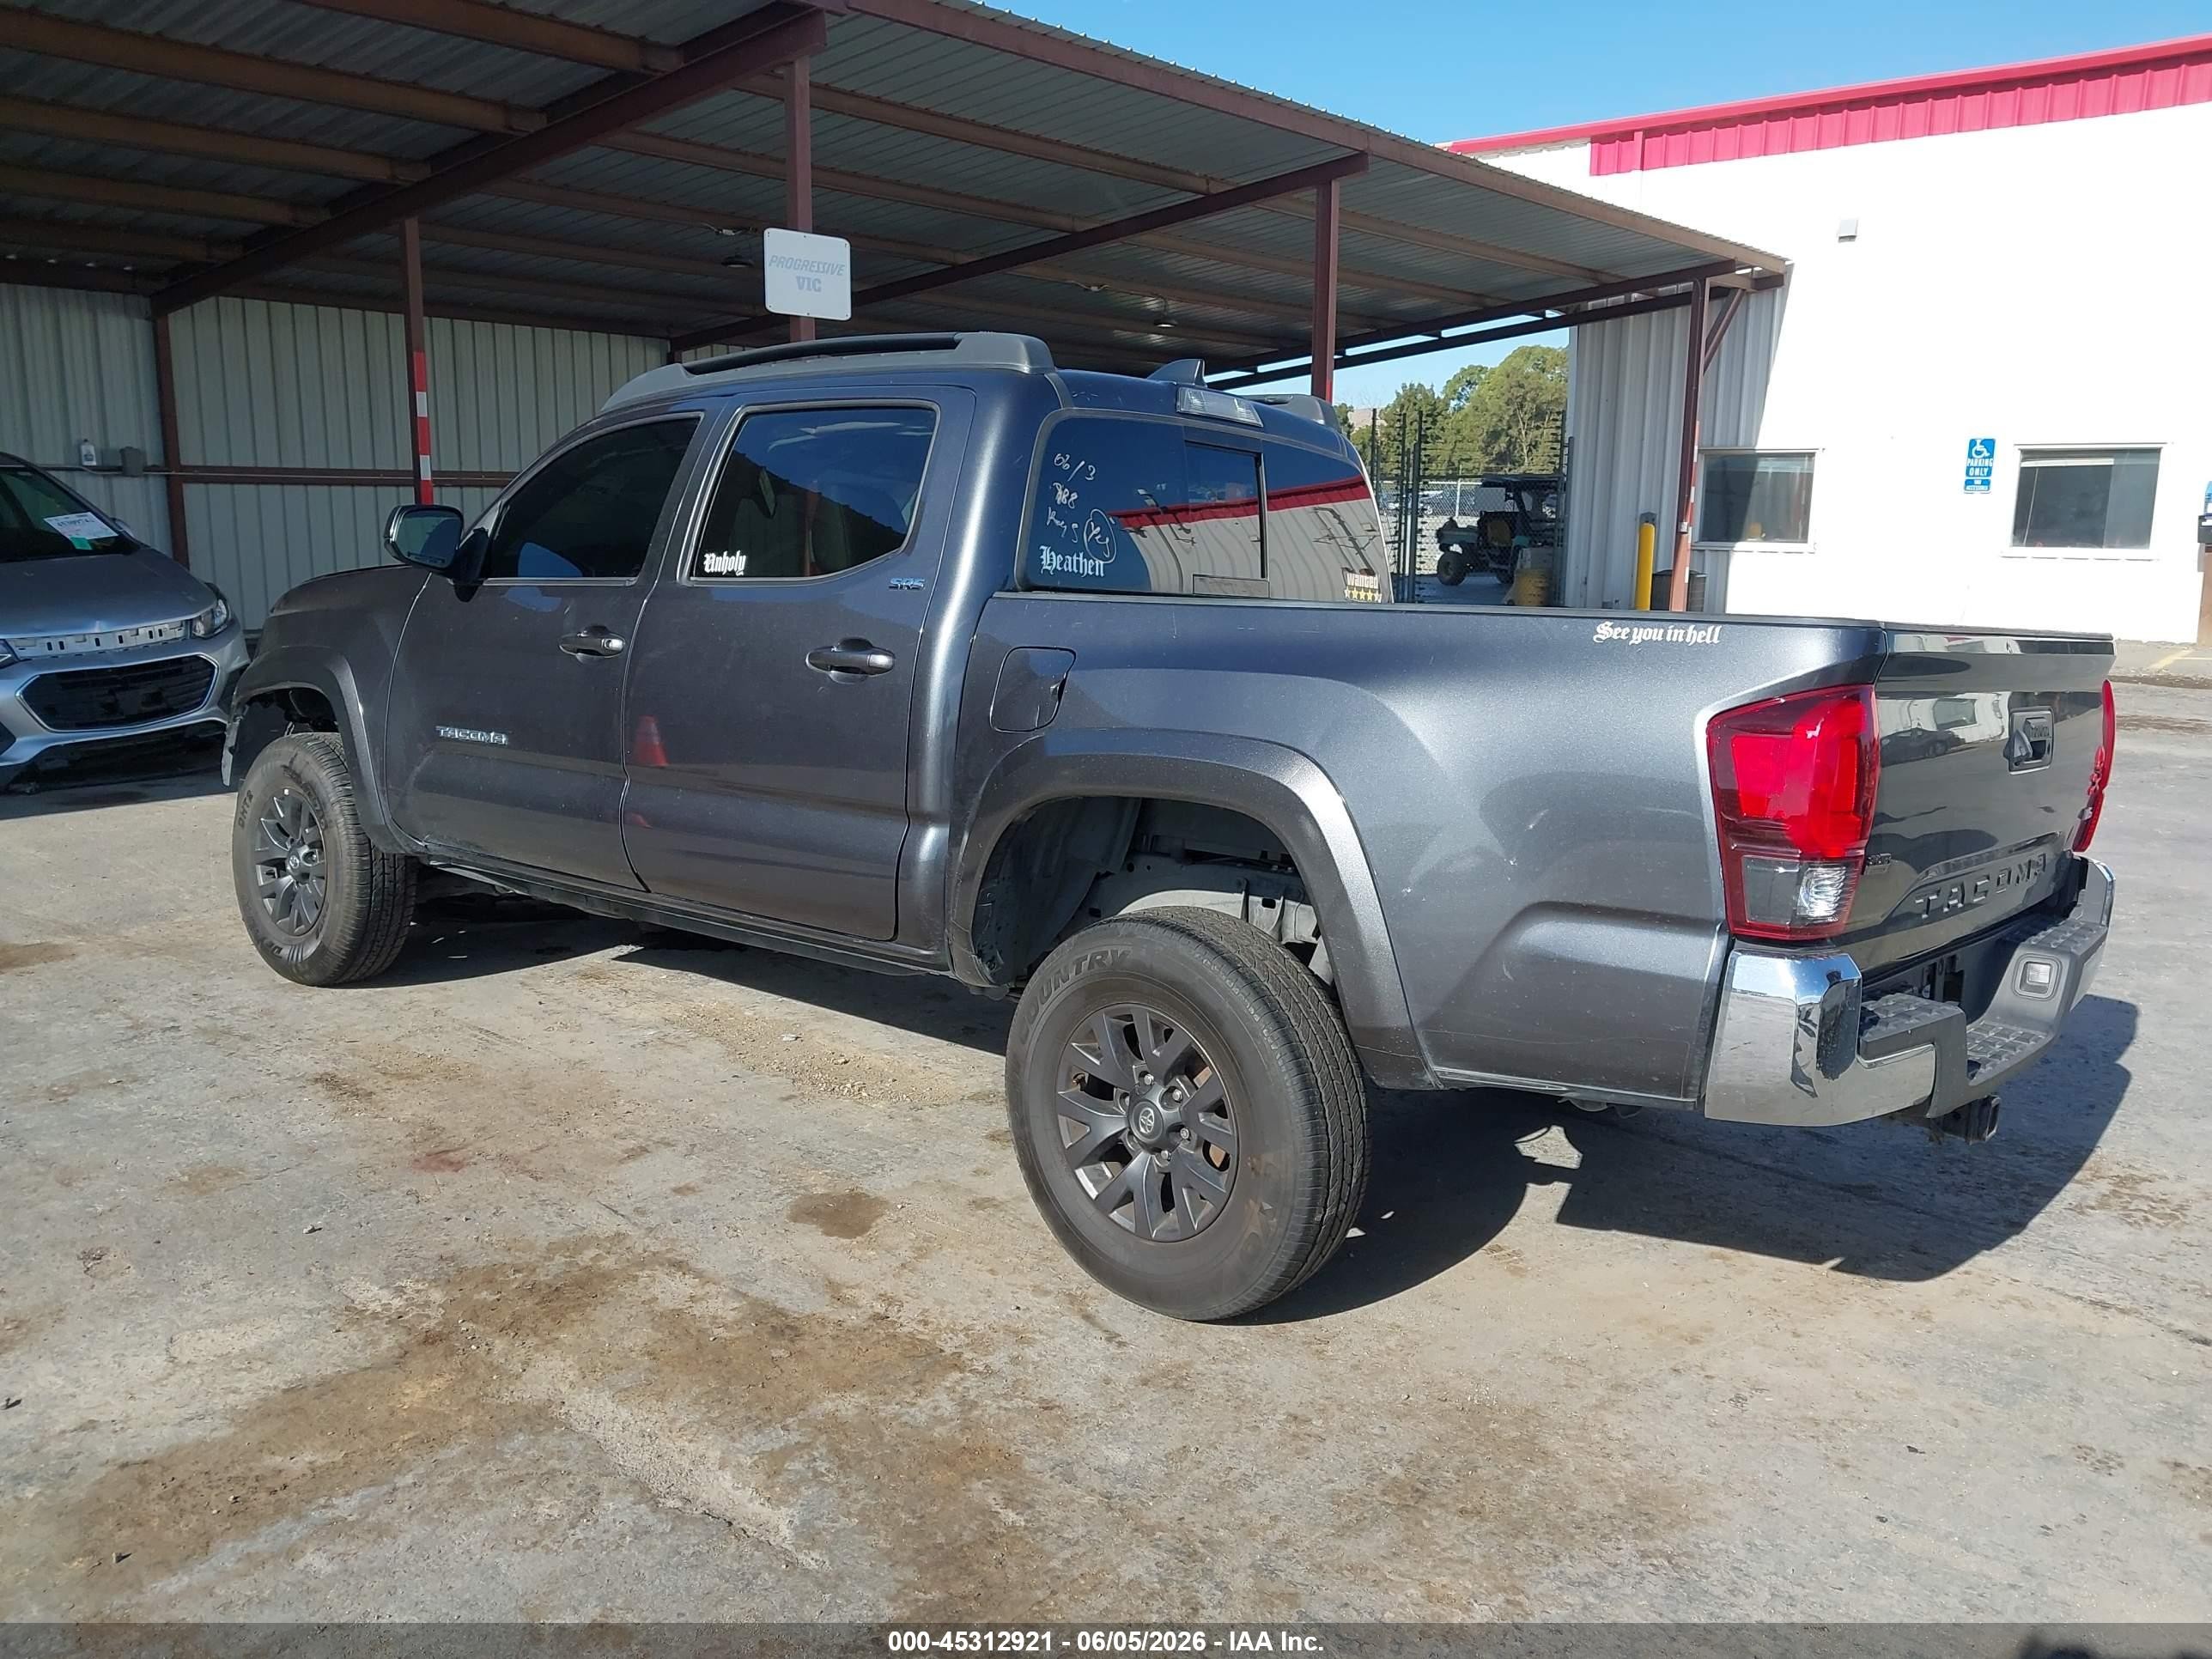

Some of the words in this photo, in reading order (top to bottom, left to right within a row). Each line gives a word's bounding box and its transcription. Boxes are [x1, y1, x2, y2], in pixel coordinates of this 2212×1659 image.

[768, 254, 846, 276] PROGRESSIVE
[1967, 458, 1993, 466] PARKING
[1969, 466, 1989, 477] ONLY
[703, 550, 747, 576] Unholy
[1039, 544, 1105, 577] Heathen
[1593, 621, 1631, 643] See
[1629, 626, 1664, 645] you
[1665, 625, 1685, 642] in
[1684, 625, 1722, 646] hell
[1914, 853, 2047, 920] TACOMA
